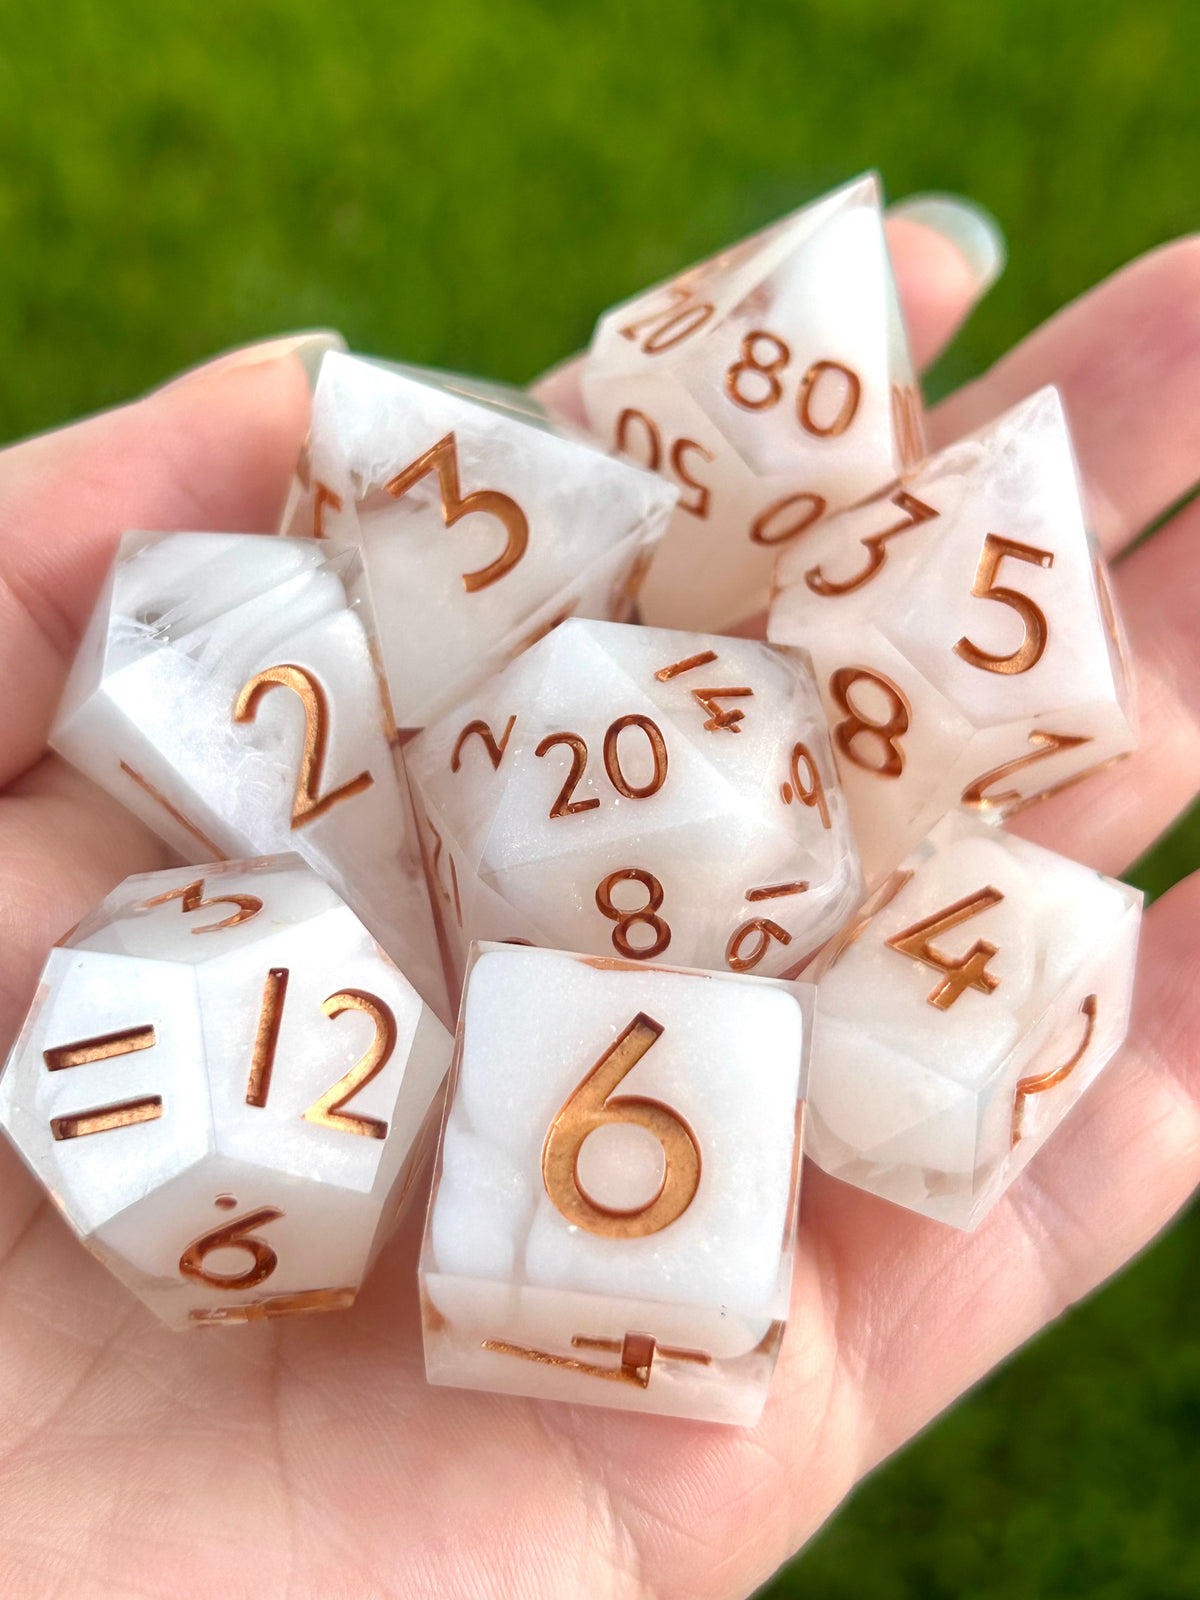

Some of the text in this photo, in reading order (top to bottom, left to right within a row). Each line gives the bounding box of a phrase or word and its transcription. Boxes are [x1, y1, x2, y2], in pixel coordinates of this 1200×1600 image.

[725, 329, 860, 438] 80
[385, 430, 530, 593] 3
[805, 490, 941, 597] 3
[952, 533, 1054, 675] 5
[233, 663, 374, 831] 2
[451, 714, 517, 773] 2
[534, 714, 669, 819] 20
[829, 664, 912, 780] 8
[140, 879, 264, 935] 3
[595, 867, 672, 960] 8
[884, 884, 1005, 1012] 4
[246, 967, 398, 1140] 12
[542, 1011, 702, 1240] 6
